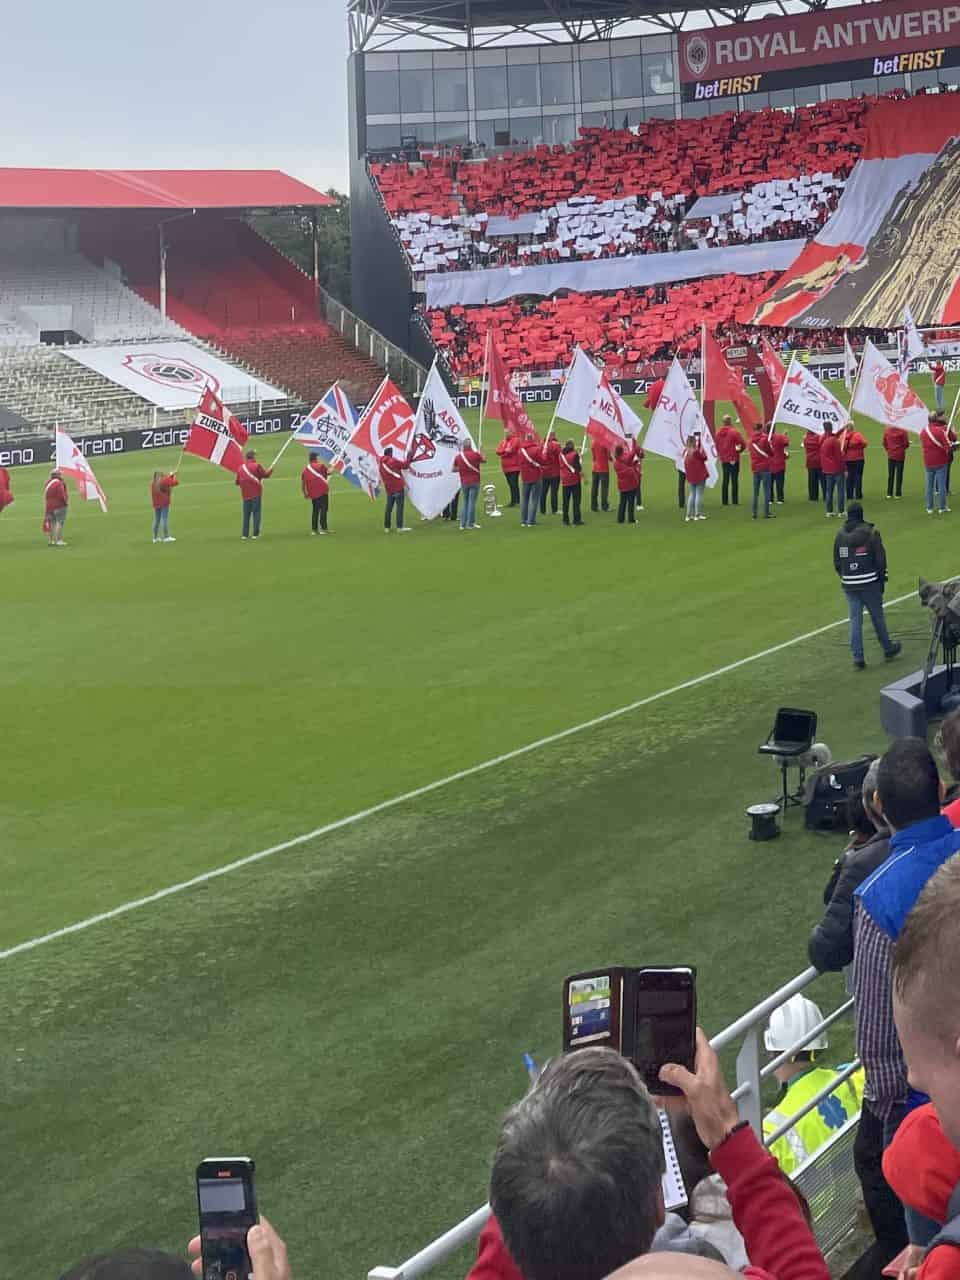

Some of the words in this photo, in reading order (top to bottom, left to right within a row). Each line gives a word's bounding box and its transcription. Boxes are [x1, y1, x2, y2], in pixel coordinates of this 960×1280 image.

[715, 29, 806, 65] ROYAL
[873, 49, 945, 76] betFIRST
[694, 74, 762, 100] betFIRST
[783, 399, 800, 415] Est.
[805, 406, 839, 423] 2003
